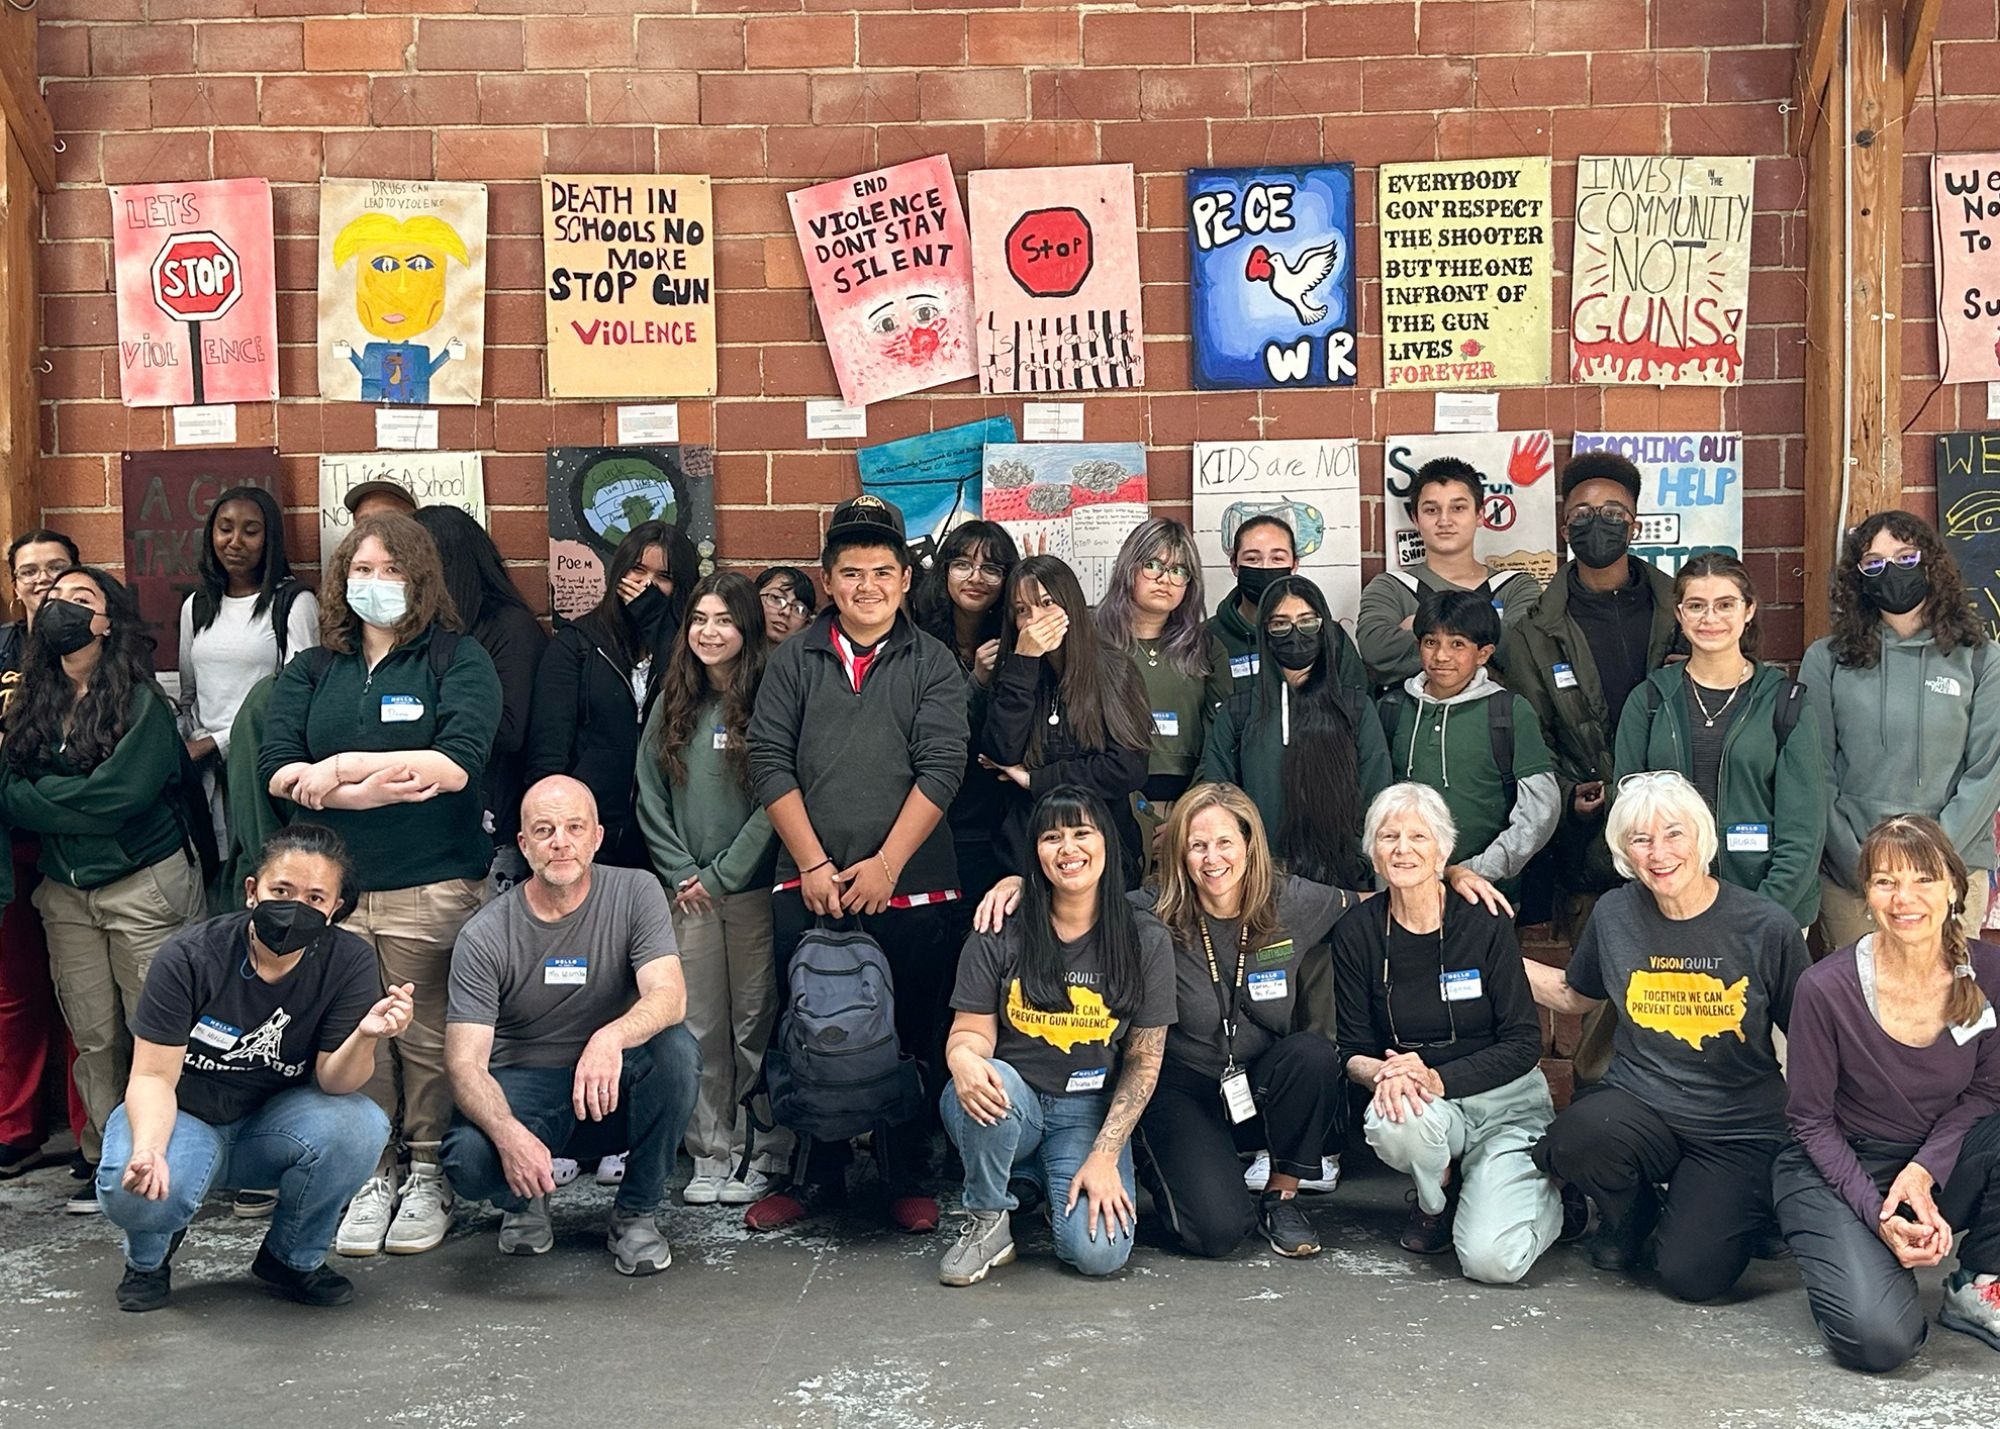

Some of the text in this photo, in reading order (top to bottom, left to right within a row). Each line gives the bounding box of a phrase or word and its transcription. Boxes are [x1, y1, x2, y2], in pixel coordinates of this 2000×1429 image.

[1388, 170, 1521, 194] EVERYBODY
[1581, 157, 1694, 194] INVEST
[1708, 169, 1716, 178] IN
[1710, 177, 1723, 186] THE
[371, 180, 429, 196] DRUGS CAN
[551, 181, 677, 215] DEATH IN
[853, 176, 887, 198] END
[125, 193, 200, 229] LET'S
[364, 198, 383, 209] LEAD
[386, 198, 396, 208] TO
[808, 188, 942, 239] VIOLENCE
[1442, 199, 1543, 219] RESPECT
[1963, 195, 2000, 223] No
[1577, 192, 1750, 242] COMMUNITY
[554, 215, 704, 246] SCHOOLS NO
[815, 208, 947, 264] DONT STAY
[1385, 226, 1544, 248] THE SHOOTER
[608, 248, 686, 271] MORE
[833, 244, 953, 294] SILENT
[1386, 257, 1533, 279] BUT THE ONE
[1612, 236, 1707, 294] NOT
[163, 253, 231, 298] STOP
[549, 267, 709, 306] STOP GUN
[1386, 283, 1527, 305] INFRONT OF
[1963, 288, 2000, 320] Su
[1388, 312, 1489, 333] THE GUN
[1389, 339, 1453, 361] LIVES
[1390, 361, 1497, 384] FOREVER
[1699, 435, 1741, 463] OUT
[1199, 445, 1264, 488] KIDS
[1266, 457, 1306, 477] are
[1316, 443, 1358, 478] NOT
[140, 475, 173, 521] A
[1657, 467, 1737, 507] HELP
[323, 507, 352, 528] NO
[1063, 971, 1103, 985] QUILT
[1644, 990, 1722, 1003] TOGETHER WE CAN
[1010, 1009, 1110, 1029] PREVENT GUN VIOLENCE
[1083, 1005, 1100, 1017] CAN
[1632, 1002, 1735, 1016] PREVENT GUN VIOLENCE
